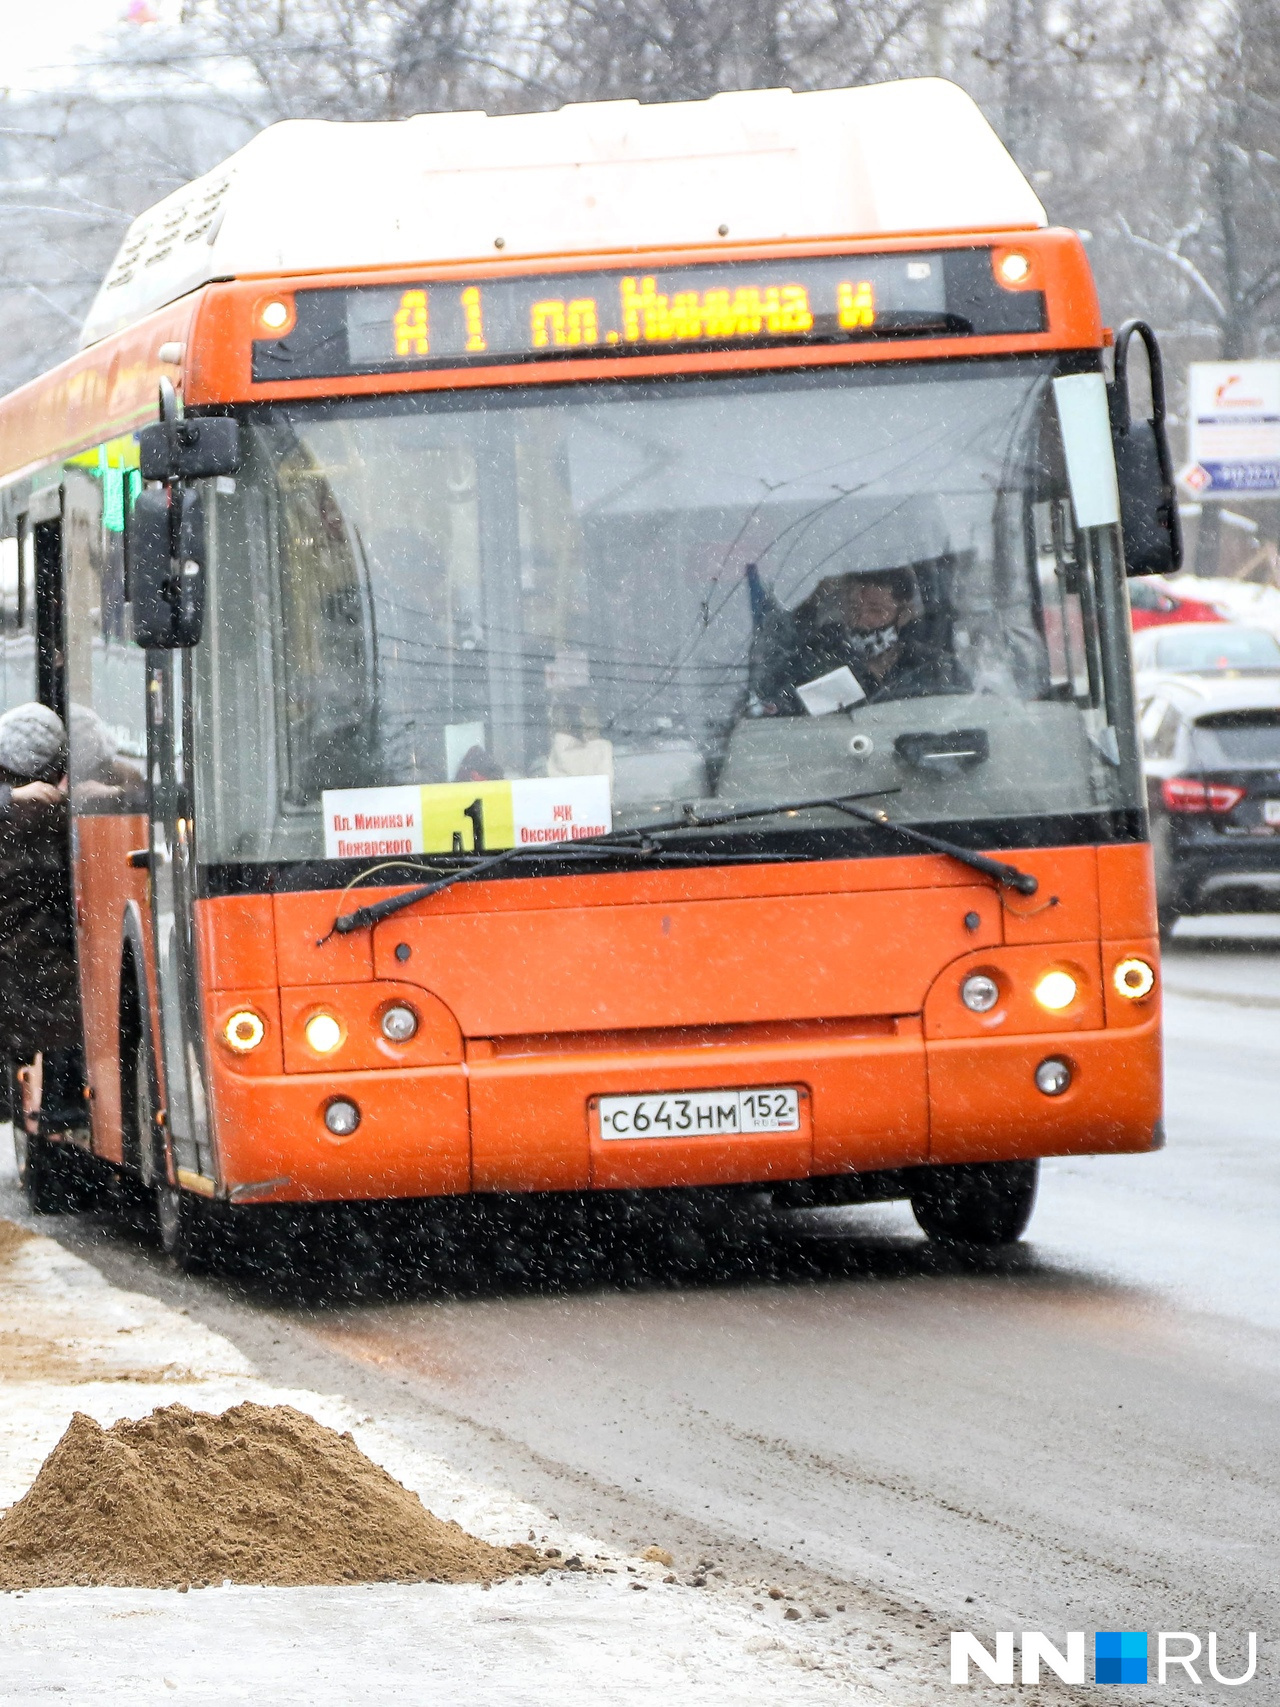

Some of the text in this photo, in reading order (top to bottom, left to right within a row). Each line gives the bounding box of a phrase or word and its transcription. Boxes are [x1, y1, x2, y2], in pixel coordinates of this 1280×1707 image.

[461, 285, 487, 352] 1
[838, 281, 874, 328] и
[406, 813, 414, 828] и
[553, 805, 572, 821] ЖК
[463, 798, 484, 852] 1
[521, 823, 568, 842] Окский
[338, 839, 412, 857] Пожарского
[744, 1094, 789, 1118] 152
[754, 1118, 778, 1127] RUS
